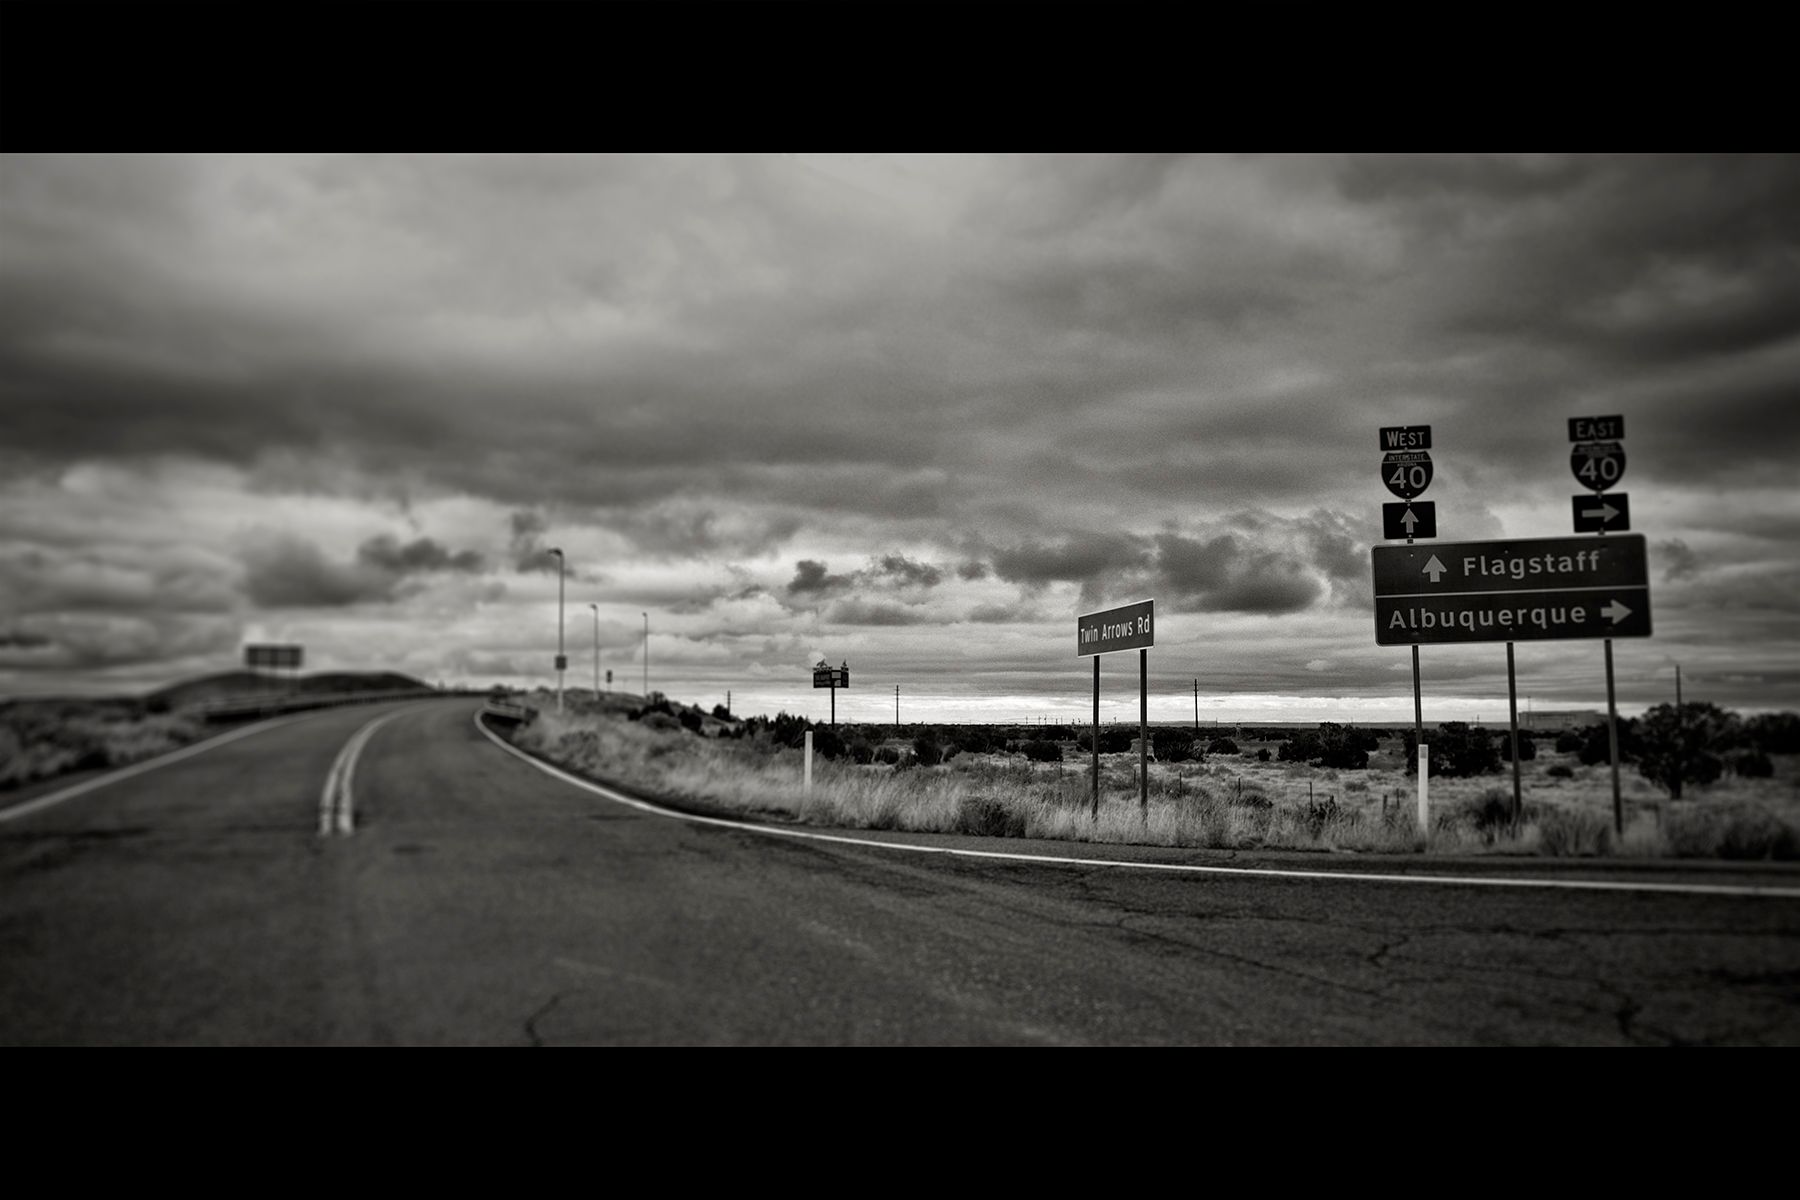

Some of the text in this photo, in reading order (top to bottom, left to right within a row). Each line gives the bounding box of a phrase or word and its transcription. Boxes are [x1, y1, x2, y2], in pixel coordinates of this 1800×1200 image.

[1386, 431, 1425, 447] WEST
[1576, 421, 1615, 438] EAST
[1388, 453, 1425, 461] INTERSTATE
[1389, 466, 1427, 489] 40
[1579, 457, 1619, 481] 40
[1463, 551, 1600, 579] Flagstaff
[1081, 613, 1150, 644] Twin Arrows Rd
[1389, 606, 1586, 632] Albuquerque
